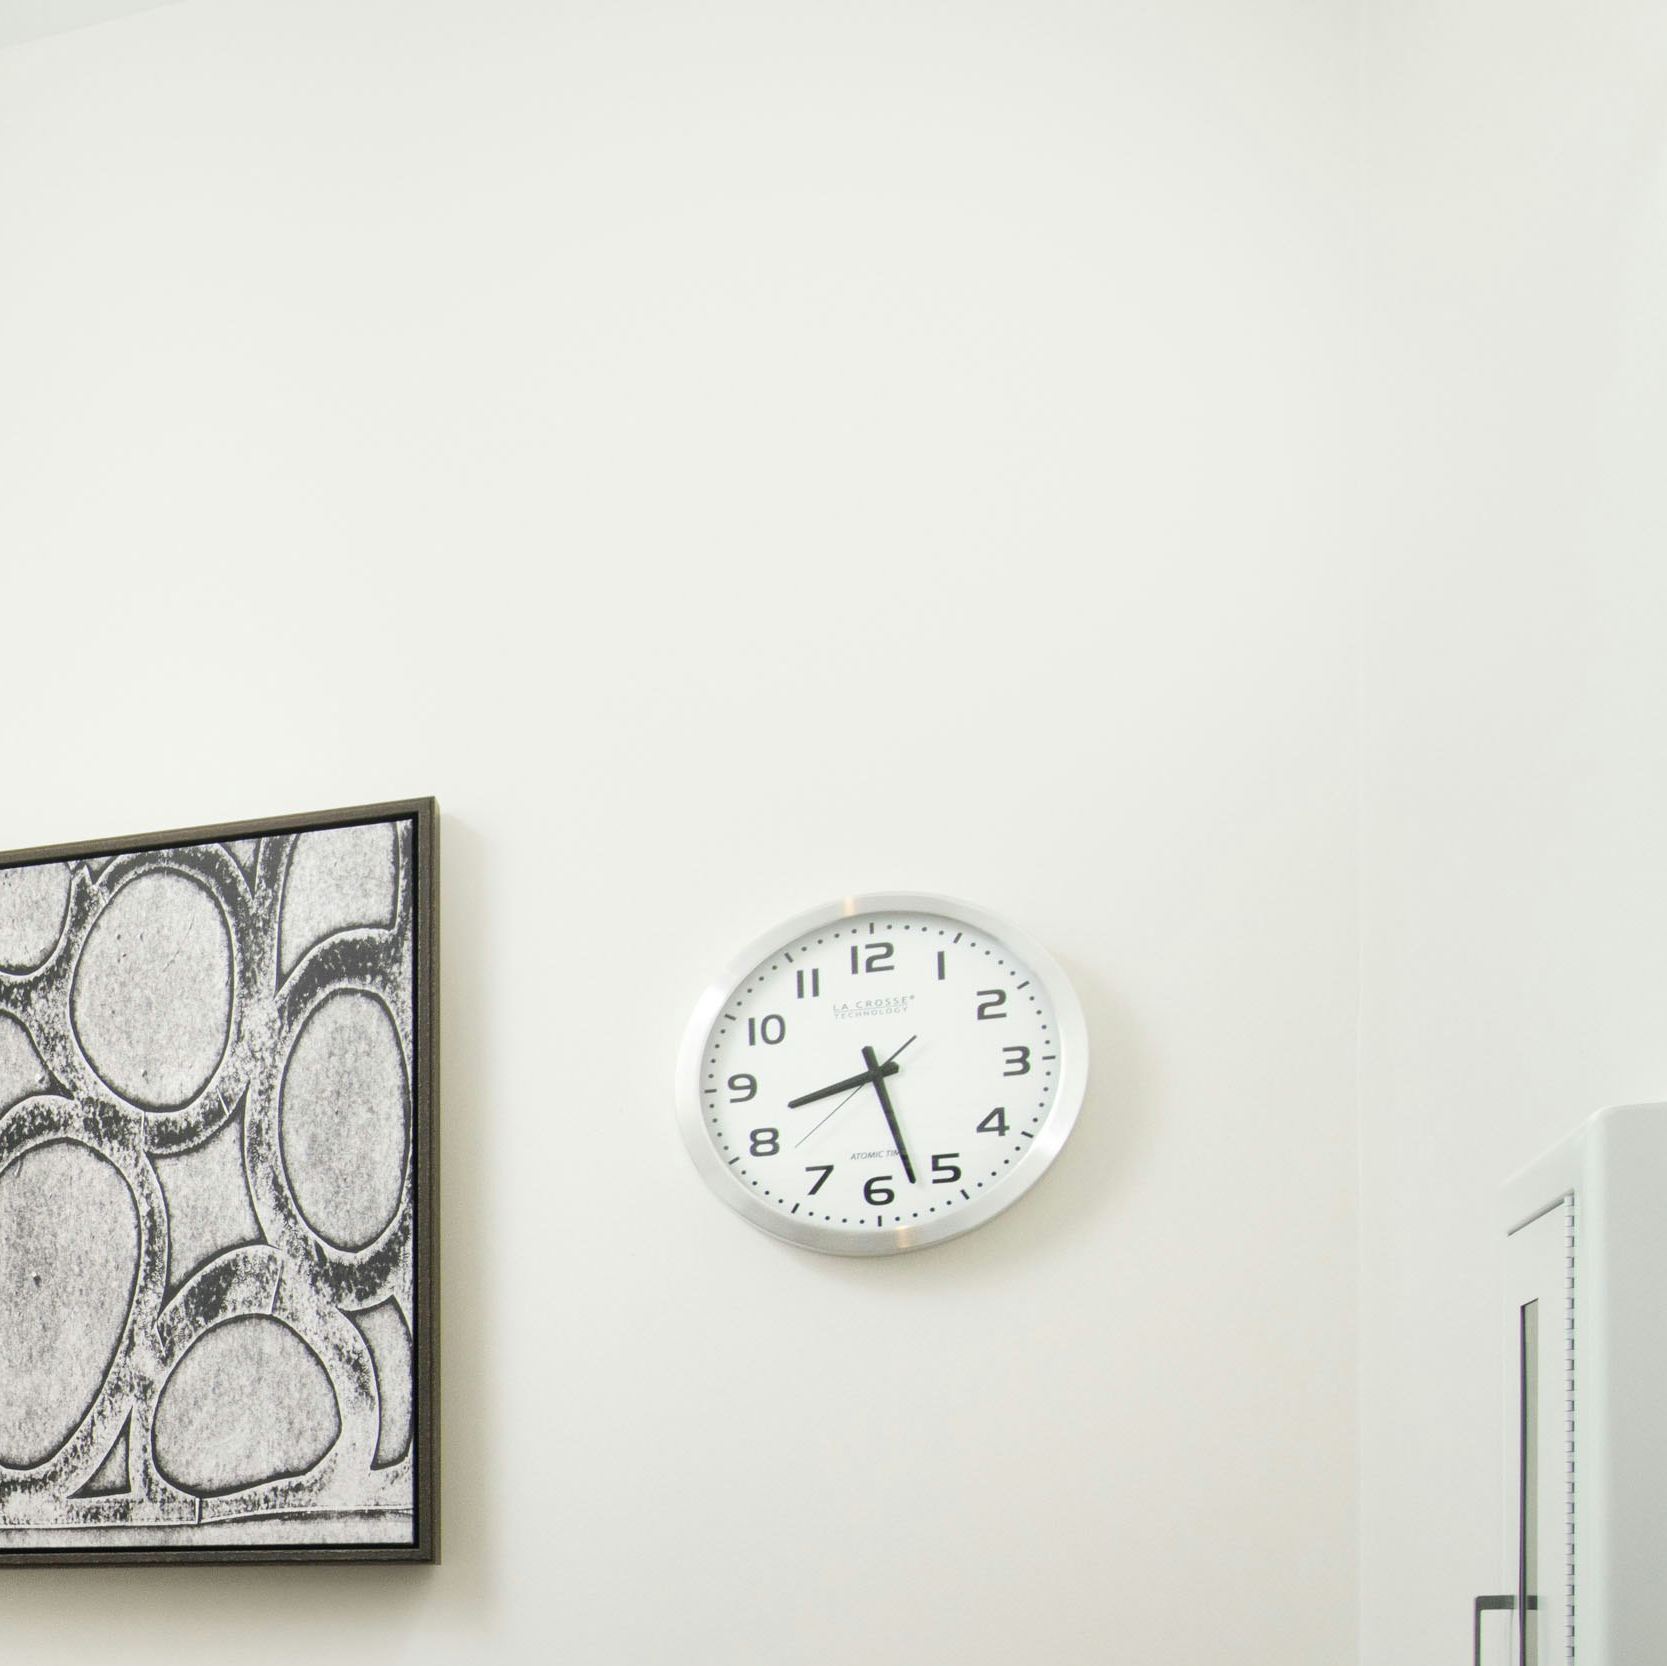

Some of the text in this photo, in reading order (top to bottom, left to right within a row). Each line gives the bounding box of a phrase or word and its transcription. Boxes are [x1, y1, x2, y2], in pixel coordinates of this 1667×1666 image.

[850, 941, 895, 975] 12
[937, 950, 946, 981] 1
[796, 967, 820, 999] 11
[976, 988, 1008, 1021] 2
[748, 1014, 786, 1046] 10
[1002, 1046, 1031, 1077] 3
[727, 1073, 758, 1104] 9
[975, 1106, 1010, 1137] 4
[749, 1127, 781, 1158] 8
[805, 1165, 834, 1196] 7
[931, 1152, 962, 1184] 5
[863, 1175, 895, 1206] 6
